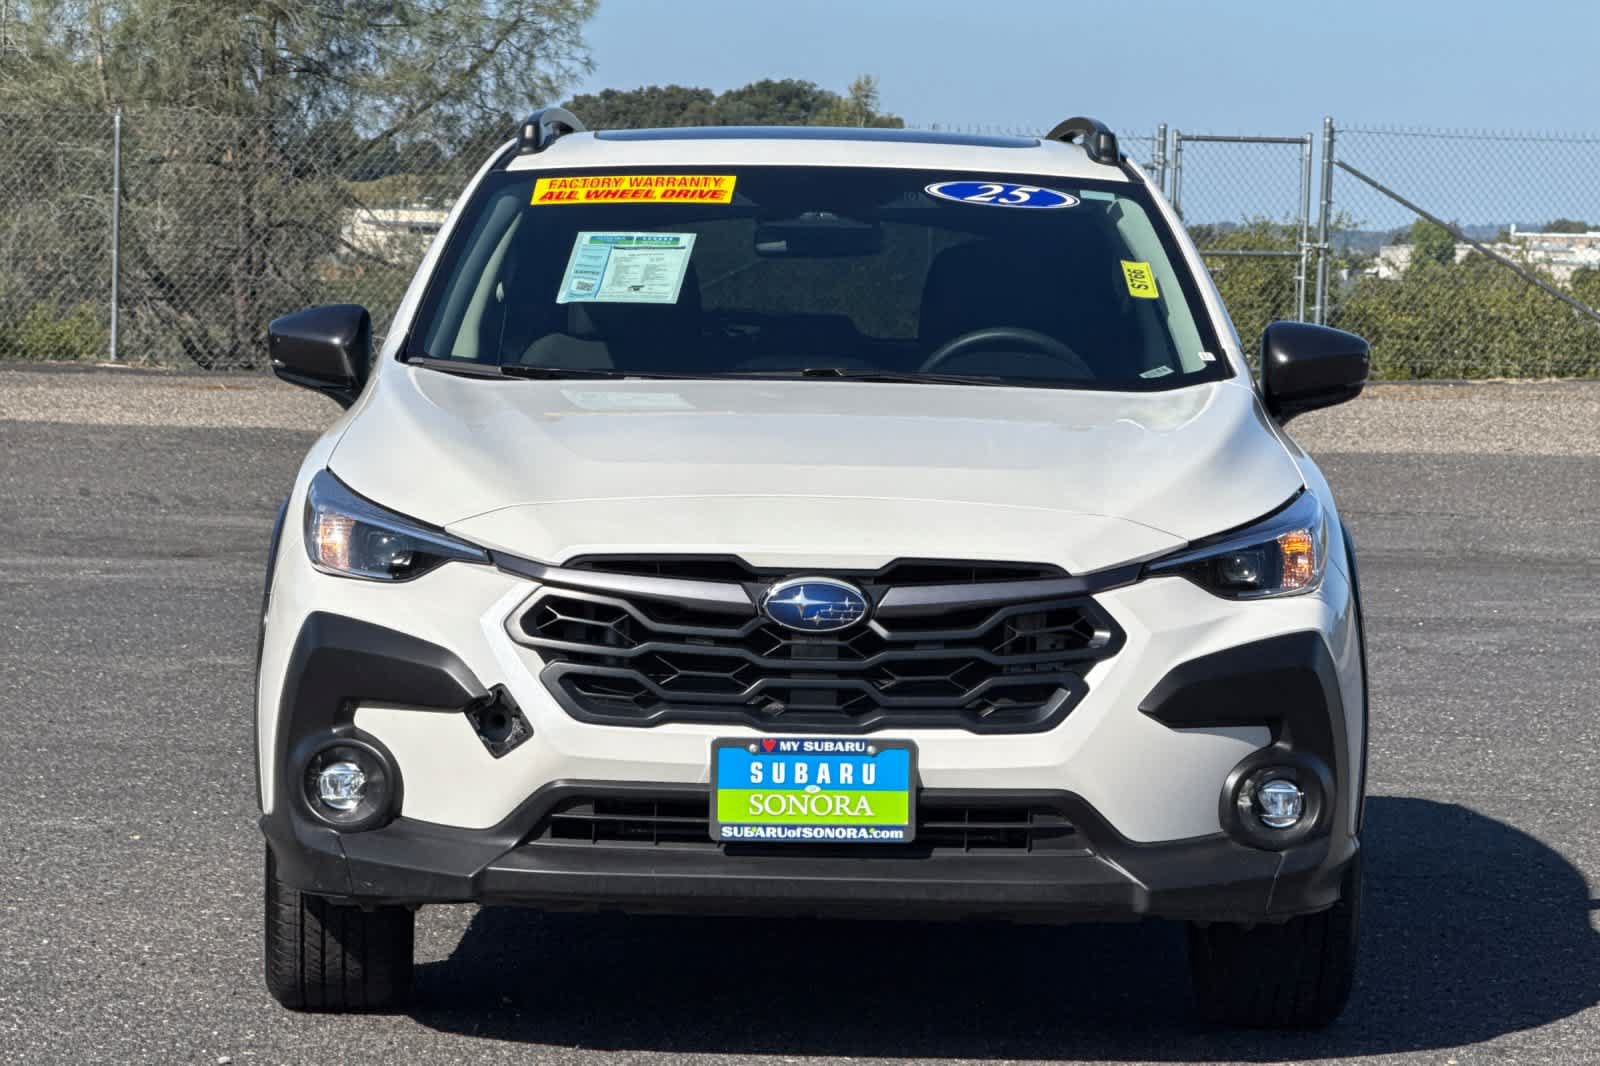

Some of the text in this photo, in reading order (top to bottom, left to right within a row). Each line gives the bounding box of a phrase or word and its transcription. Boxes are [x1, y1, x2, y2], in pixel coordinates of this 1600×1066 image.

[549, 176, 723, 189] FACTORY WARRANTY
[538, 189, 726, 201] ALL WHEEL DRIVE
[964, 184, 1041, 204] 25
[779, 741, 865, 753] MY SUBARU
[750, 762, 876, 785] SUBARU
[748, 794, 874, 816] SONORA
[721, 826, 904, 839] SUBARUofSONORA.com
